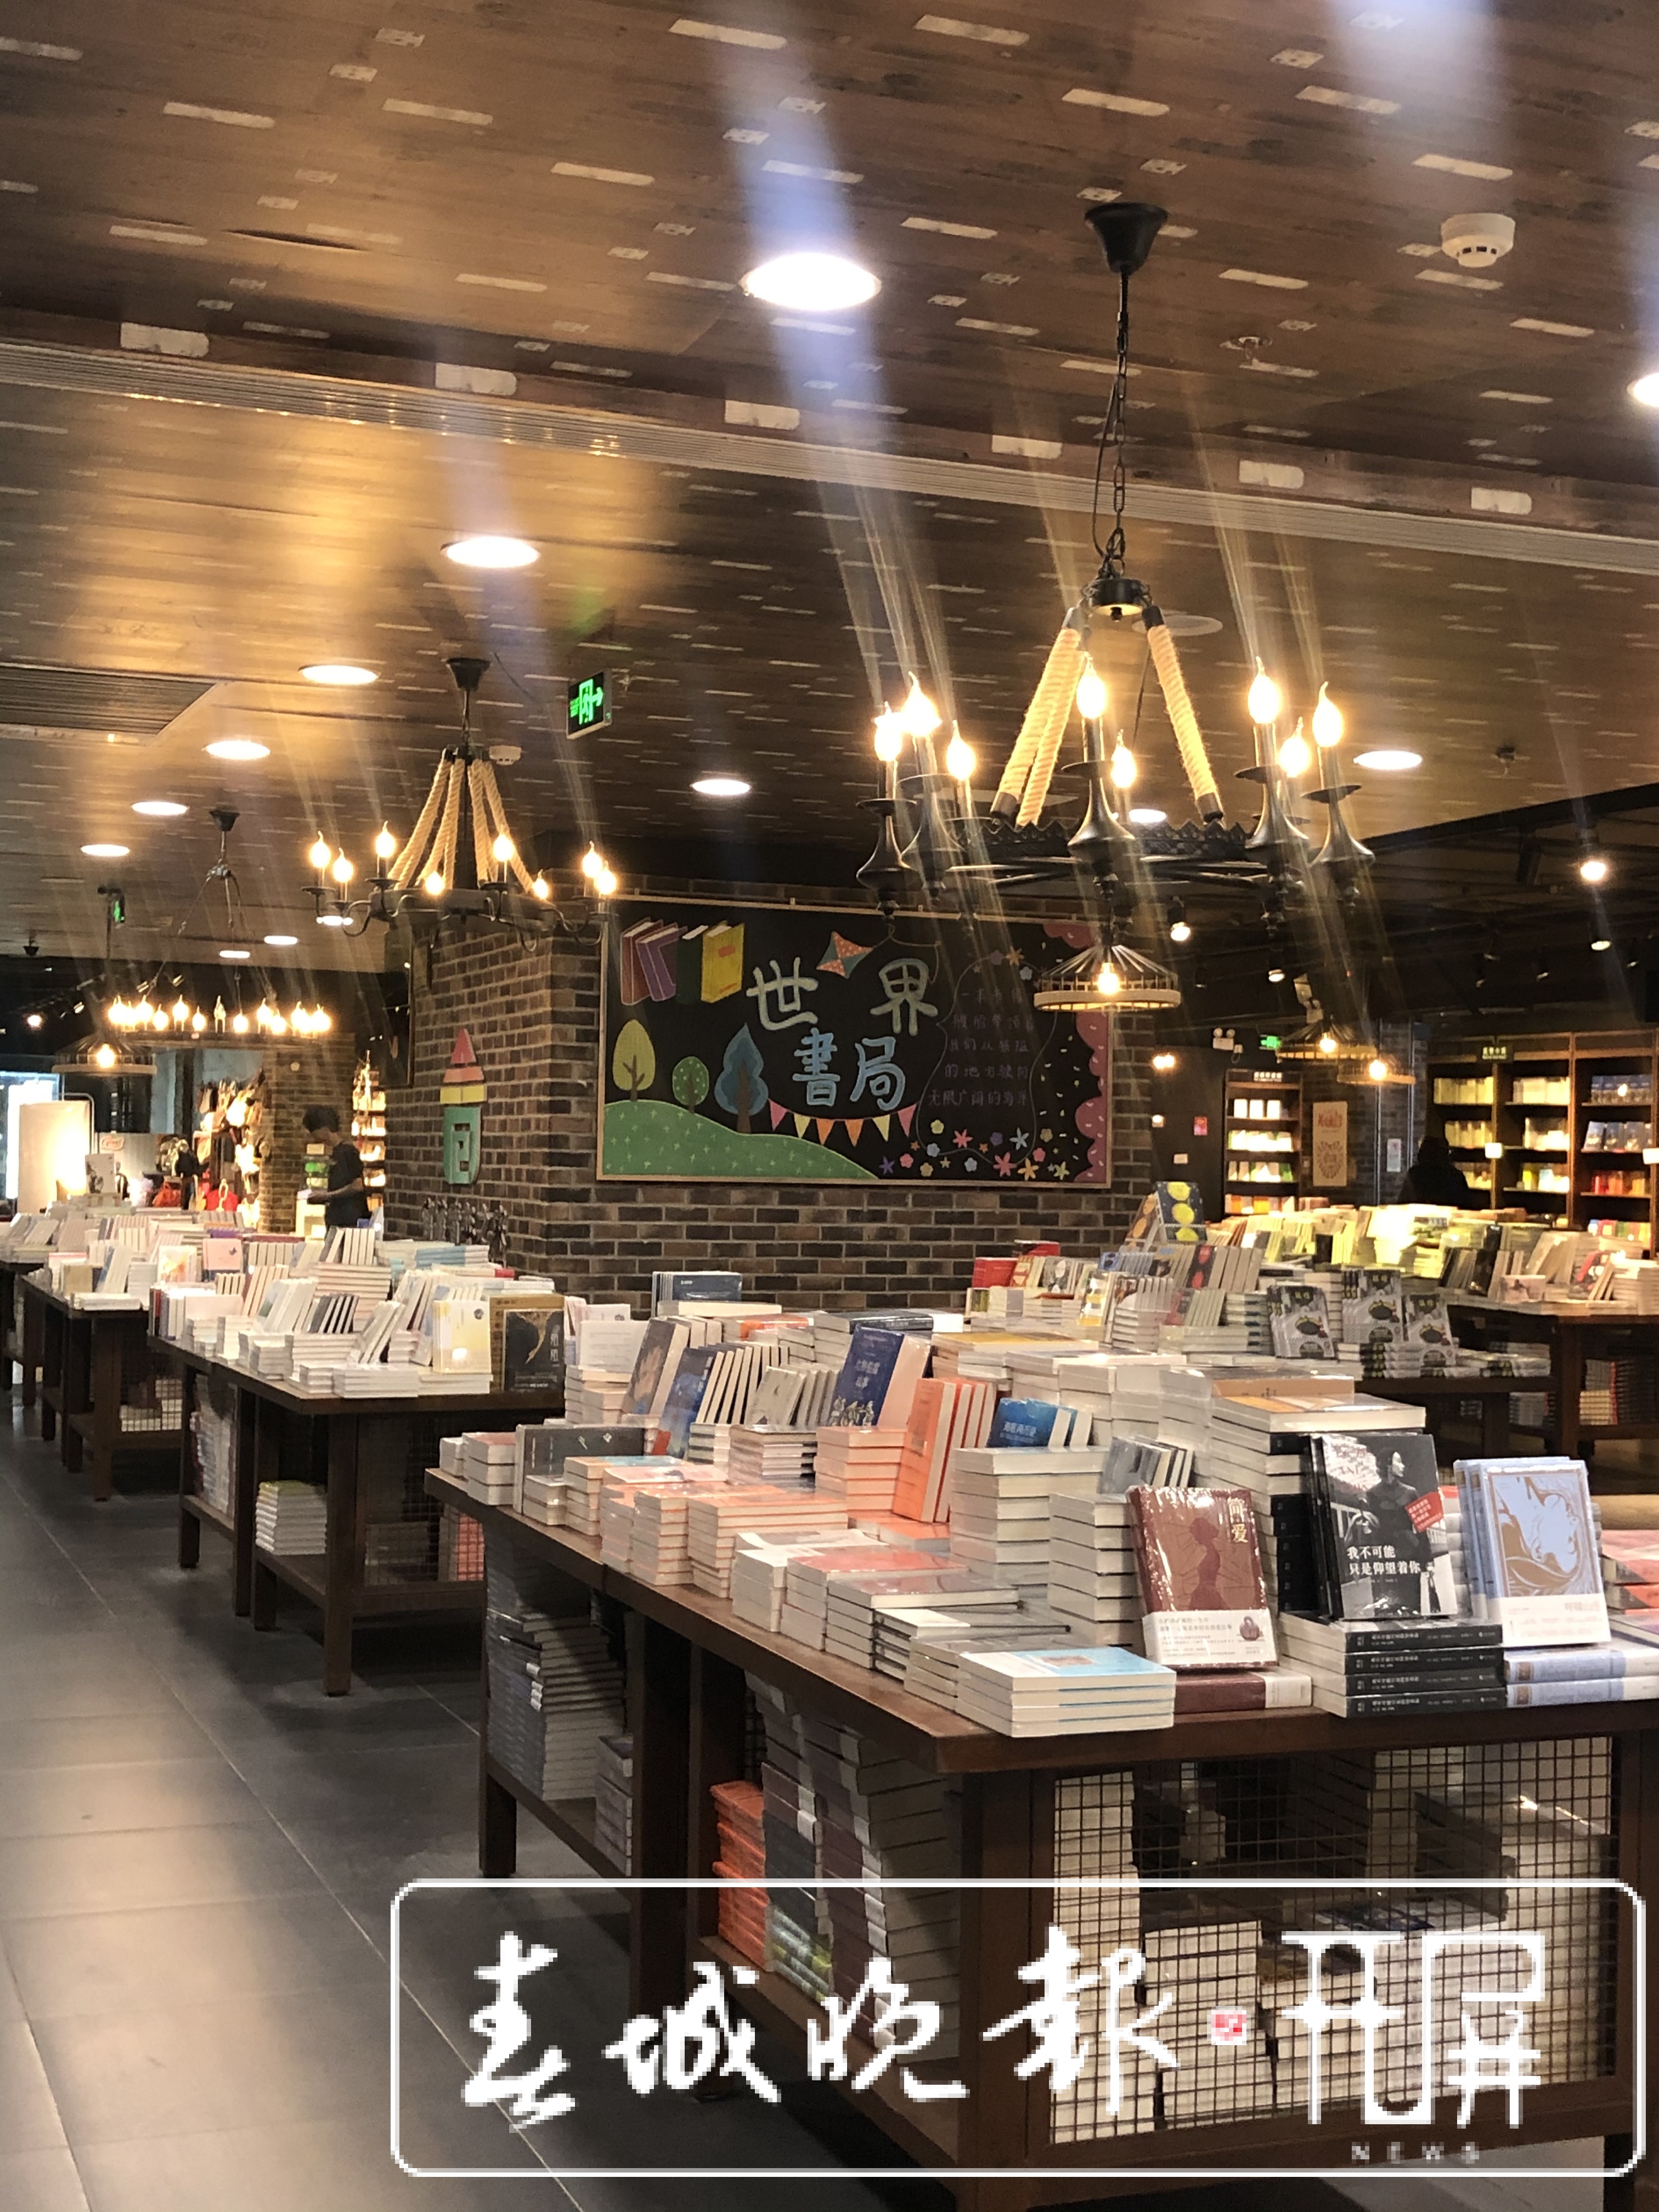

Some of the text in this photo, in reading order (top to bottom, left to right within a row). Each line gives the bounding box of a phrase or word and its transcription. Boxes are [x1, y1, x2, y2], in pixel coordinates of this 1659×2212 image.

[746, 957, 938, 1036] 世界
[792, 1028, 906, 1111] 書局
[1227, 1498, 1249, 1543] 简爱
[1347, 1545, 1396, 1560] 我不可能
[1349, 1560, 1421, 1576] 只是仰望着你
